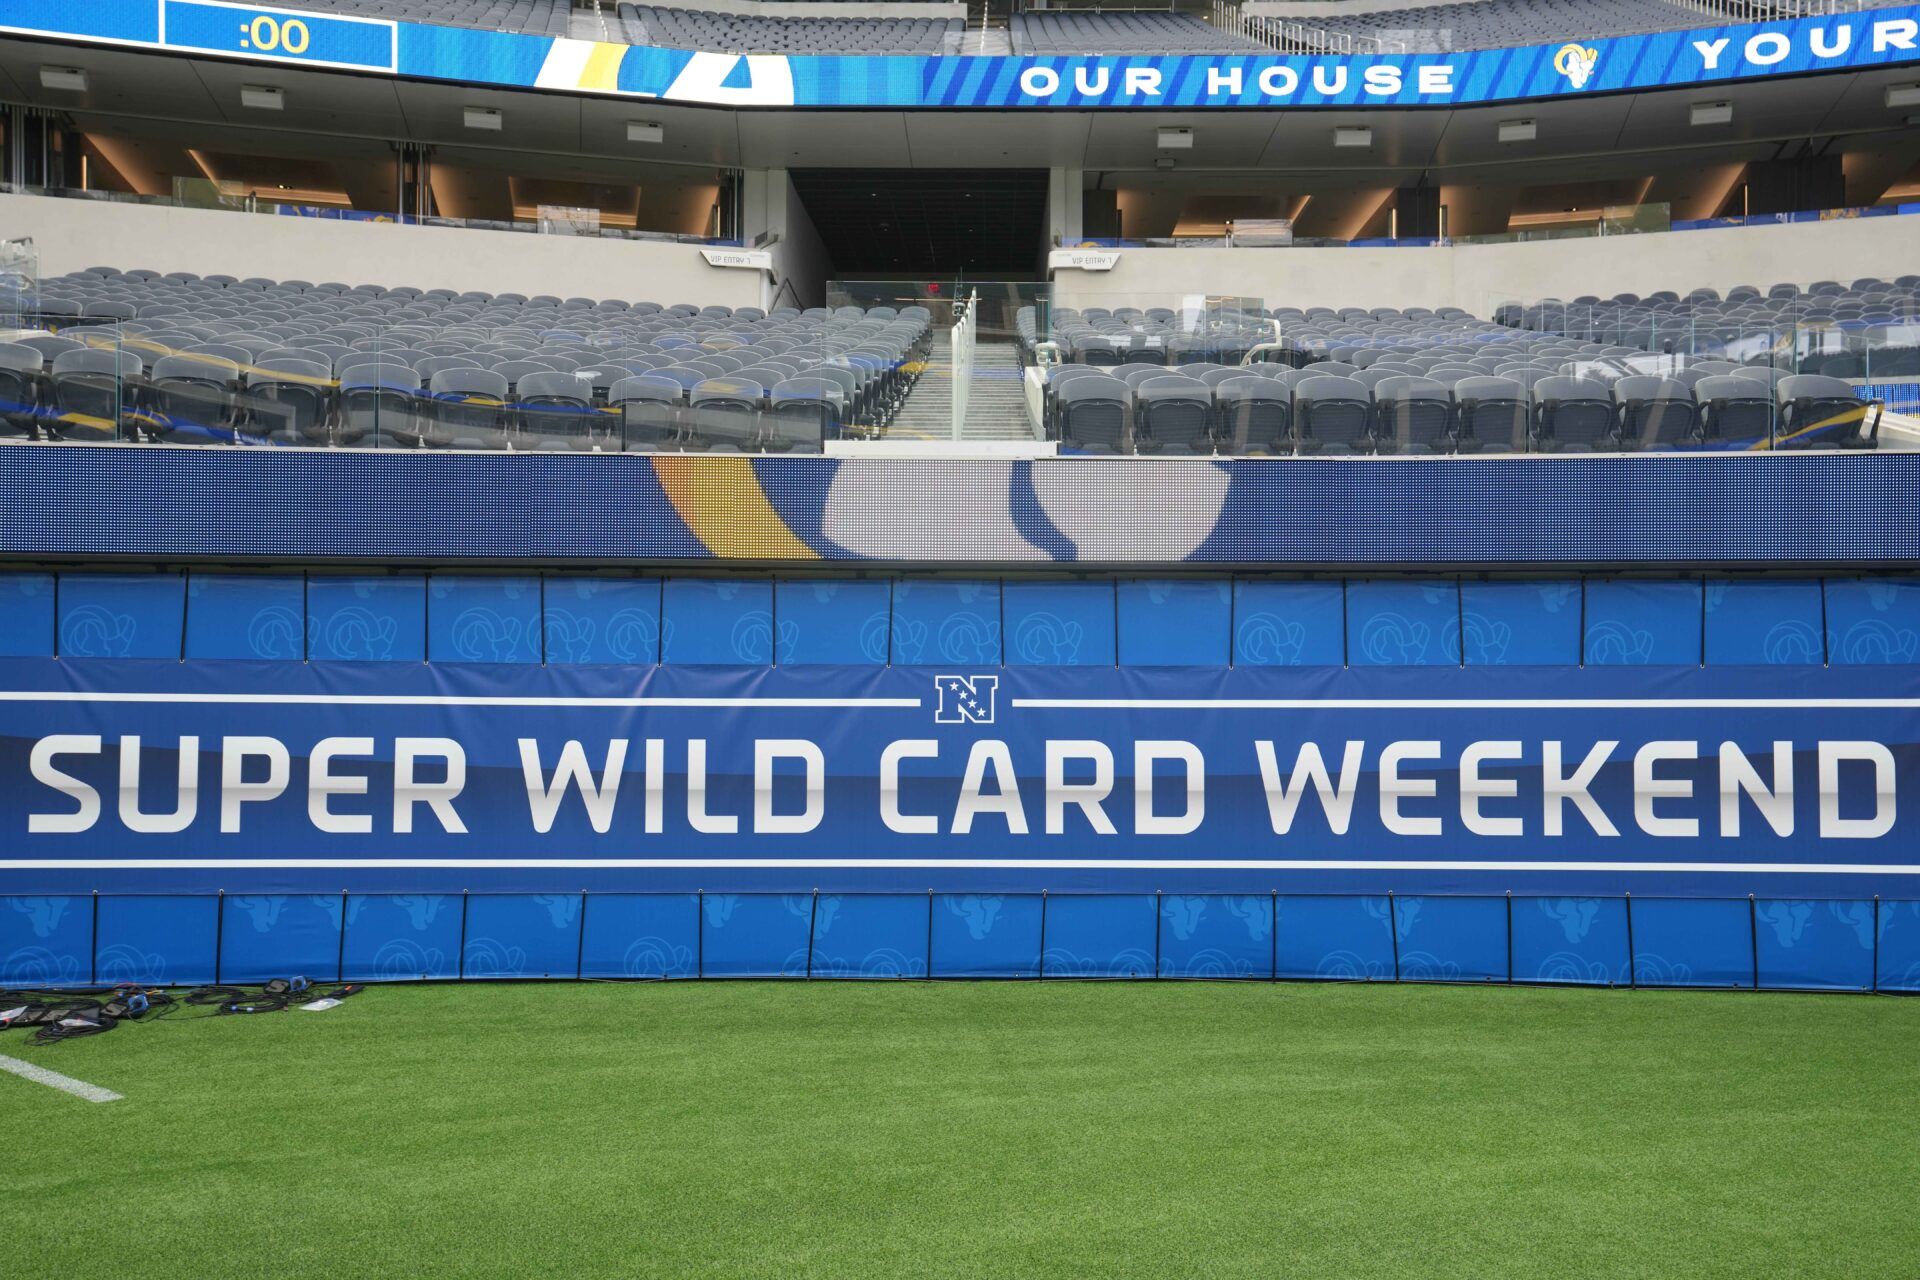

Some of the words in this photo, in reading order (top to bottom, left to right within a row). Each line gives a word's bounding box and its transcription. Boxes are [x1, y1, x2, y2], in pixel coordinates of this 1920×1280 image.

[239, 15, 310, 54] :00
[1692, 18, 1920, 70] YOUR
[1020, 66, 1162, 97] OUR
[1207, 65, 1454, 97] HOUSE
[710, 255, 722, 263] VIP
[723, 256, 745, 265] ENTRY
[1072, 256, 1083, 265] VIP
[1085, 256, 1106, 265] ENTRY
[934, 675, 999, 724] N
[27, 734, 469, 834] SUPER
[517, 737, 825, 834] WILD
[879, 738, 1206, 835] CARD
[1254, 740, 1897, 839] WEEKEND
